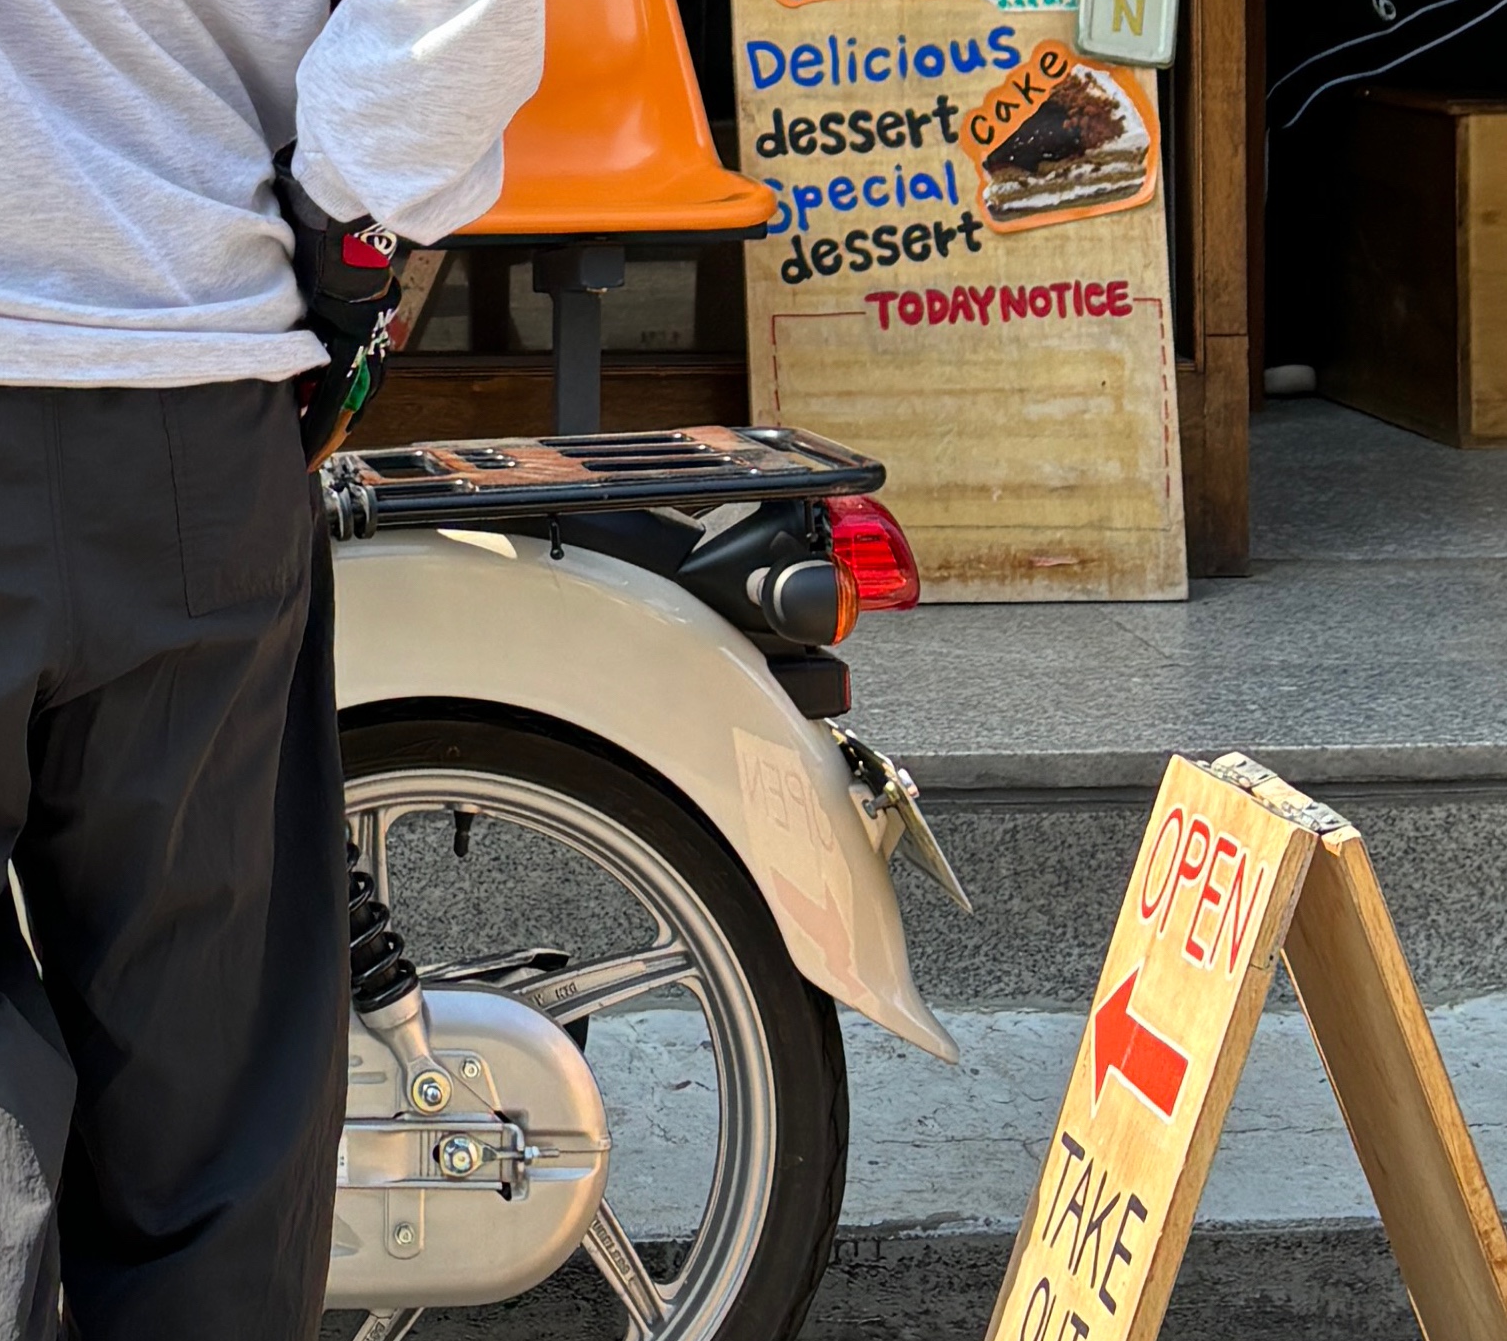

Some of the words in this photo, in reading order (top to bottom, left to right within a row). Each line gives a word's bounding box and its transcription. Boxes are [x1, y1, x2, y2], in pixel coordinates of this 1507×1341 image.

[746, 26, 1023, 91] Delicious
[755, 95, 960, 158] dessert
[780, 210, 984, 285] dessert
[864, 284, 996, 331] TODAY
[999, 279, 1133, 323] NOTICE
[1140, 805, 1266, 977] OPEN
[1042, 1131, 1148, 1316] TAKE
